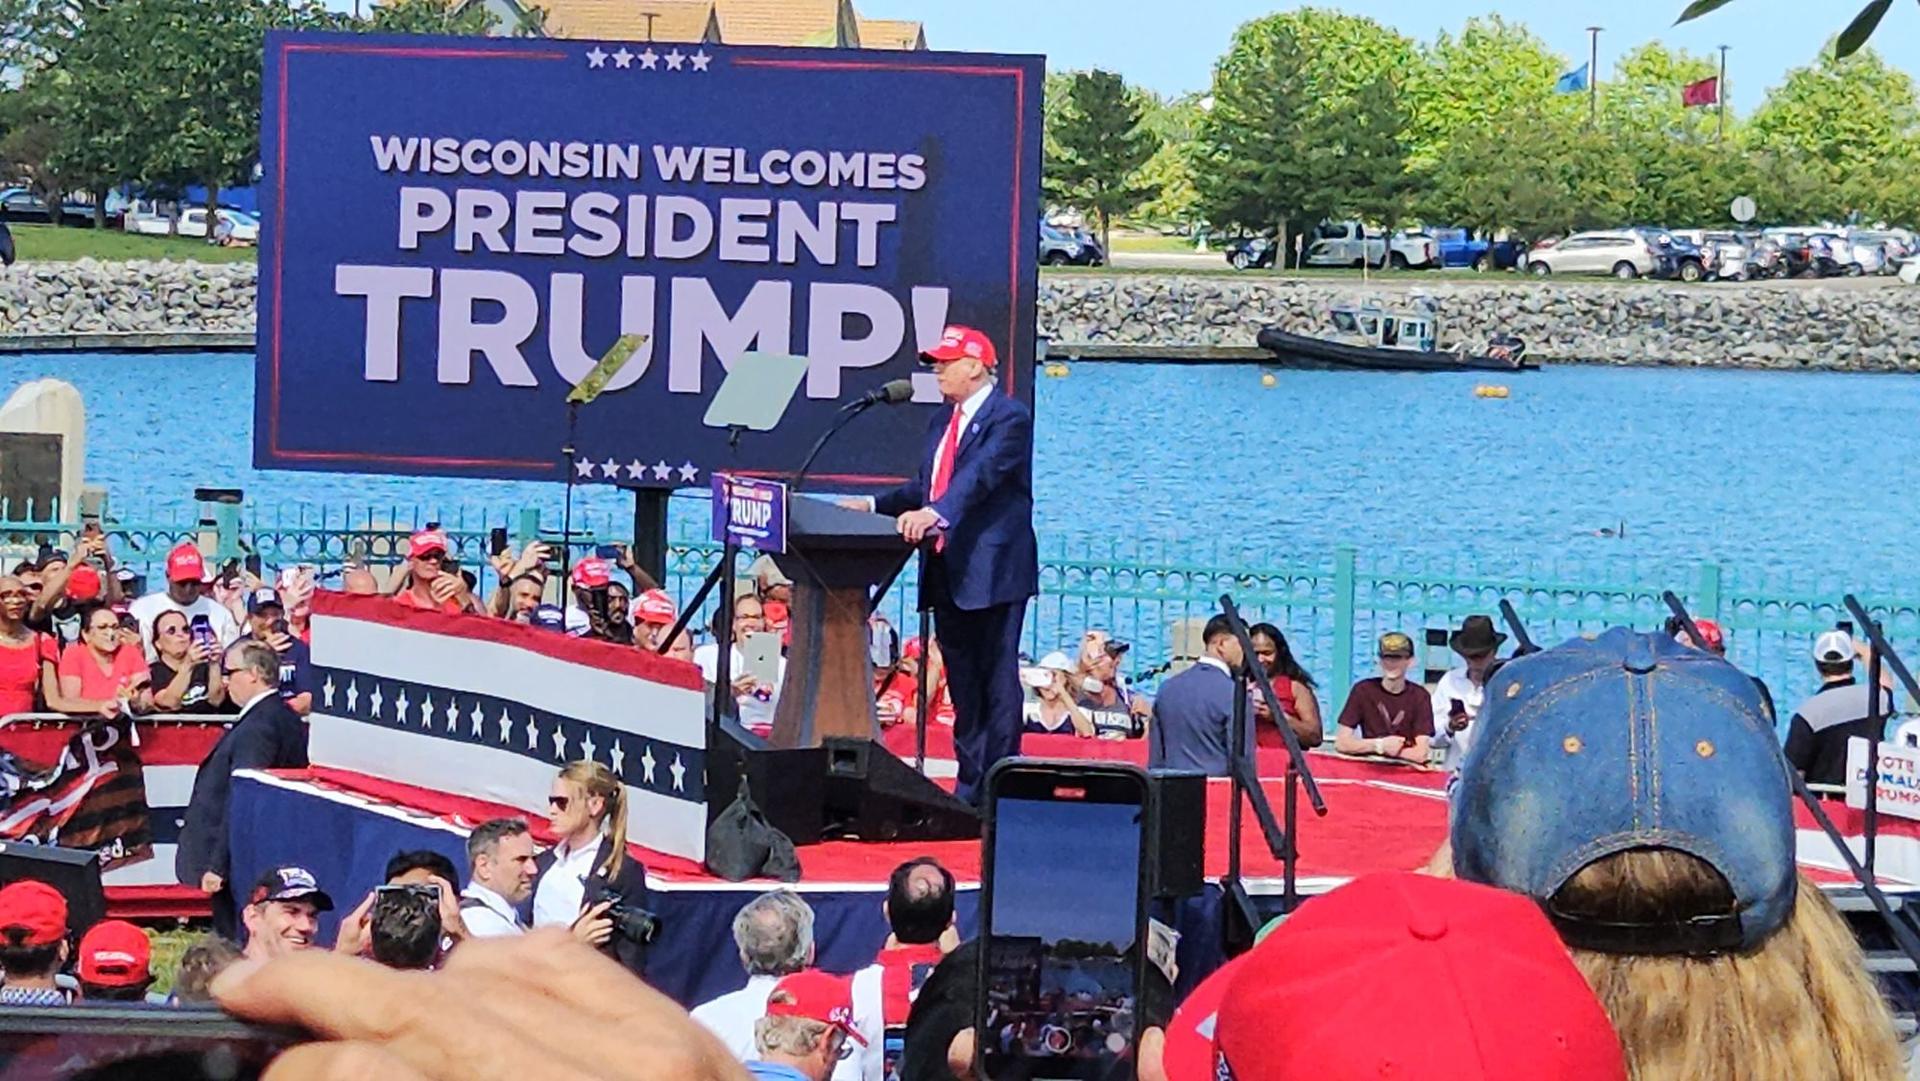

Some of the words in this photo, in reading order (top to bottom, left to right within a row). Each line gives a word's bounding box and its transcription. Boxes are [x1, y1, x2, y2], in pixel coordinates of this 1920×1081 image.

[370, 135, 640, 180] WISCONSIN
[653, 145, 927, 191] WELCOMES
[398, 186, 897, 267] PRESIDENT
[334, 264, 950, 404] TRUMP!
[723, 495, 771, 528] RUMP
[1881, 756, 1915, 774] OTE
[1874, 786, 1920, 804] RUMP
